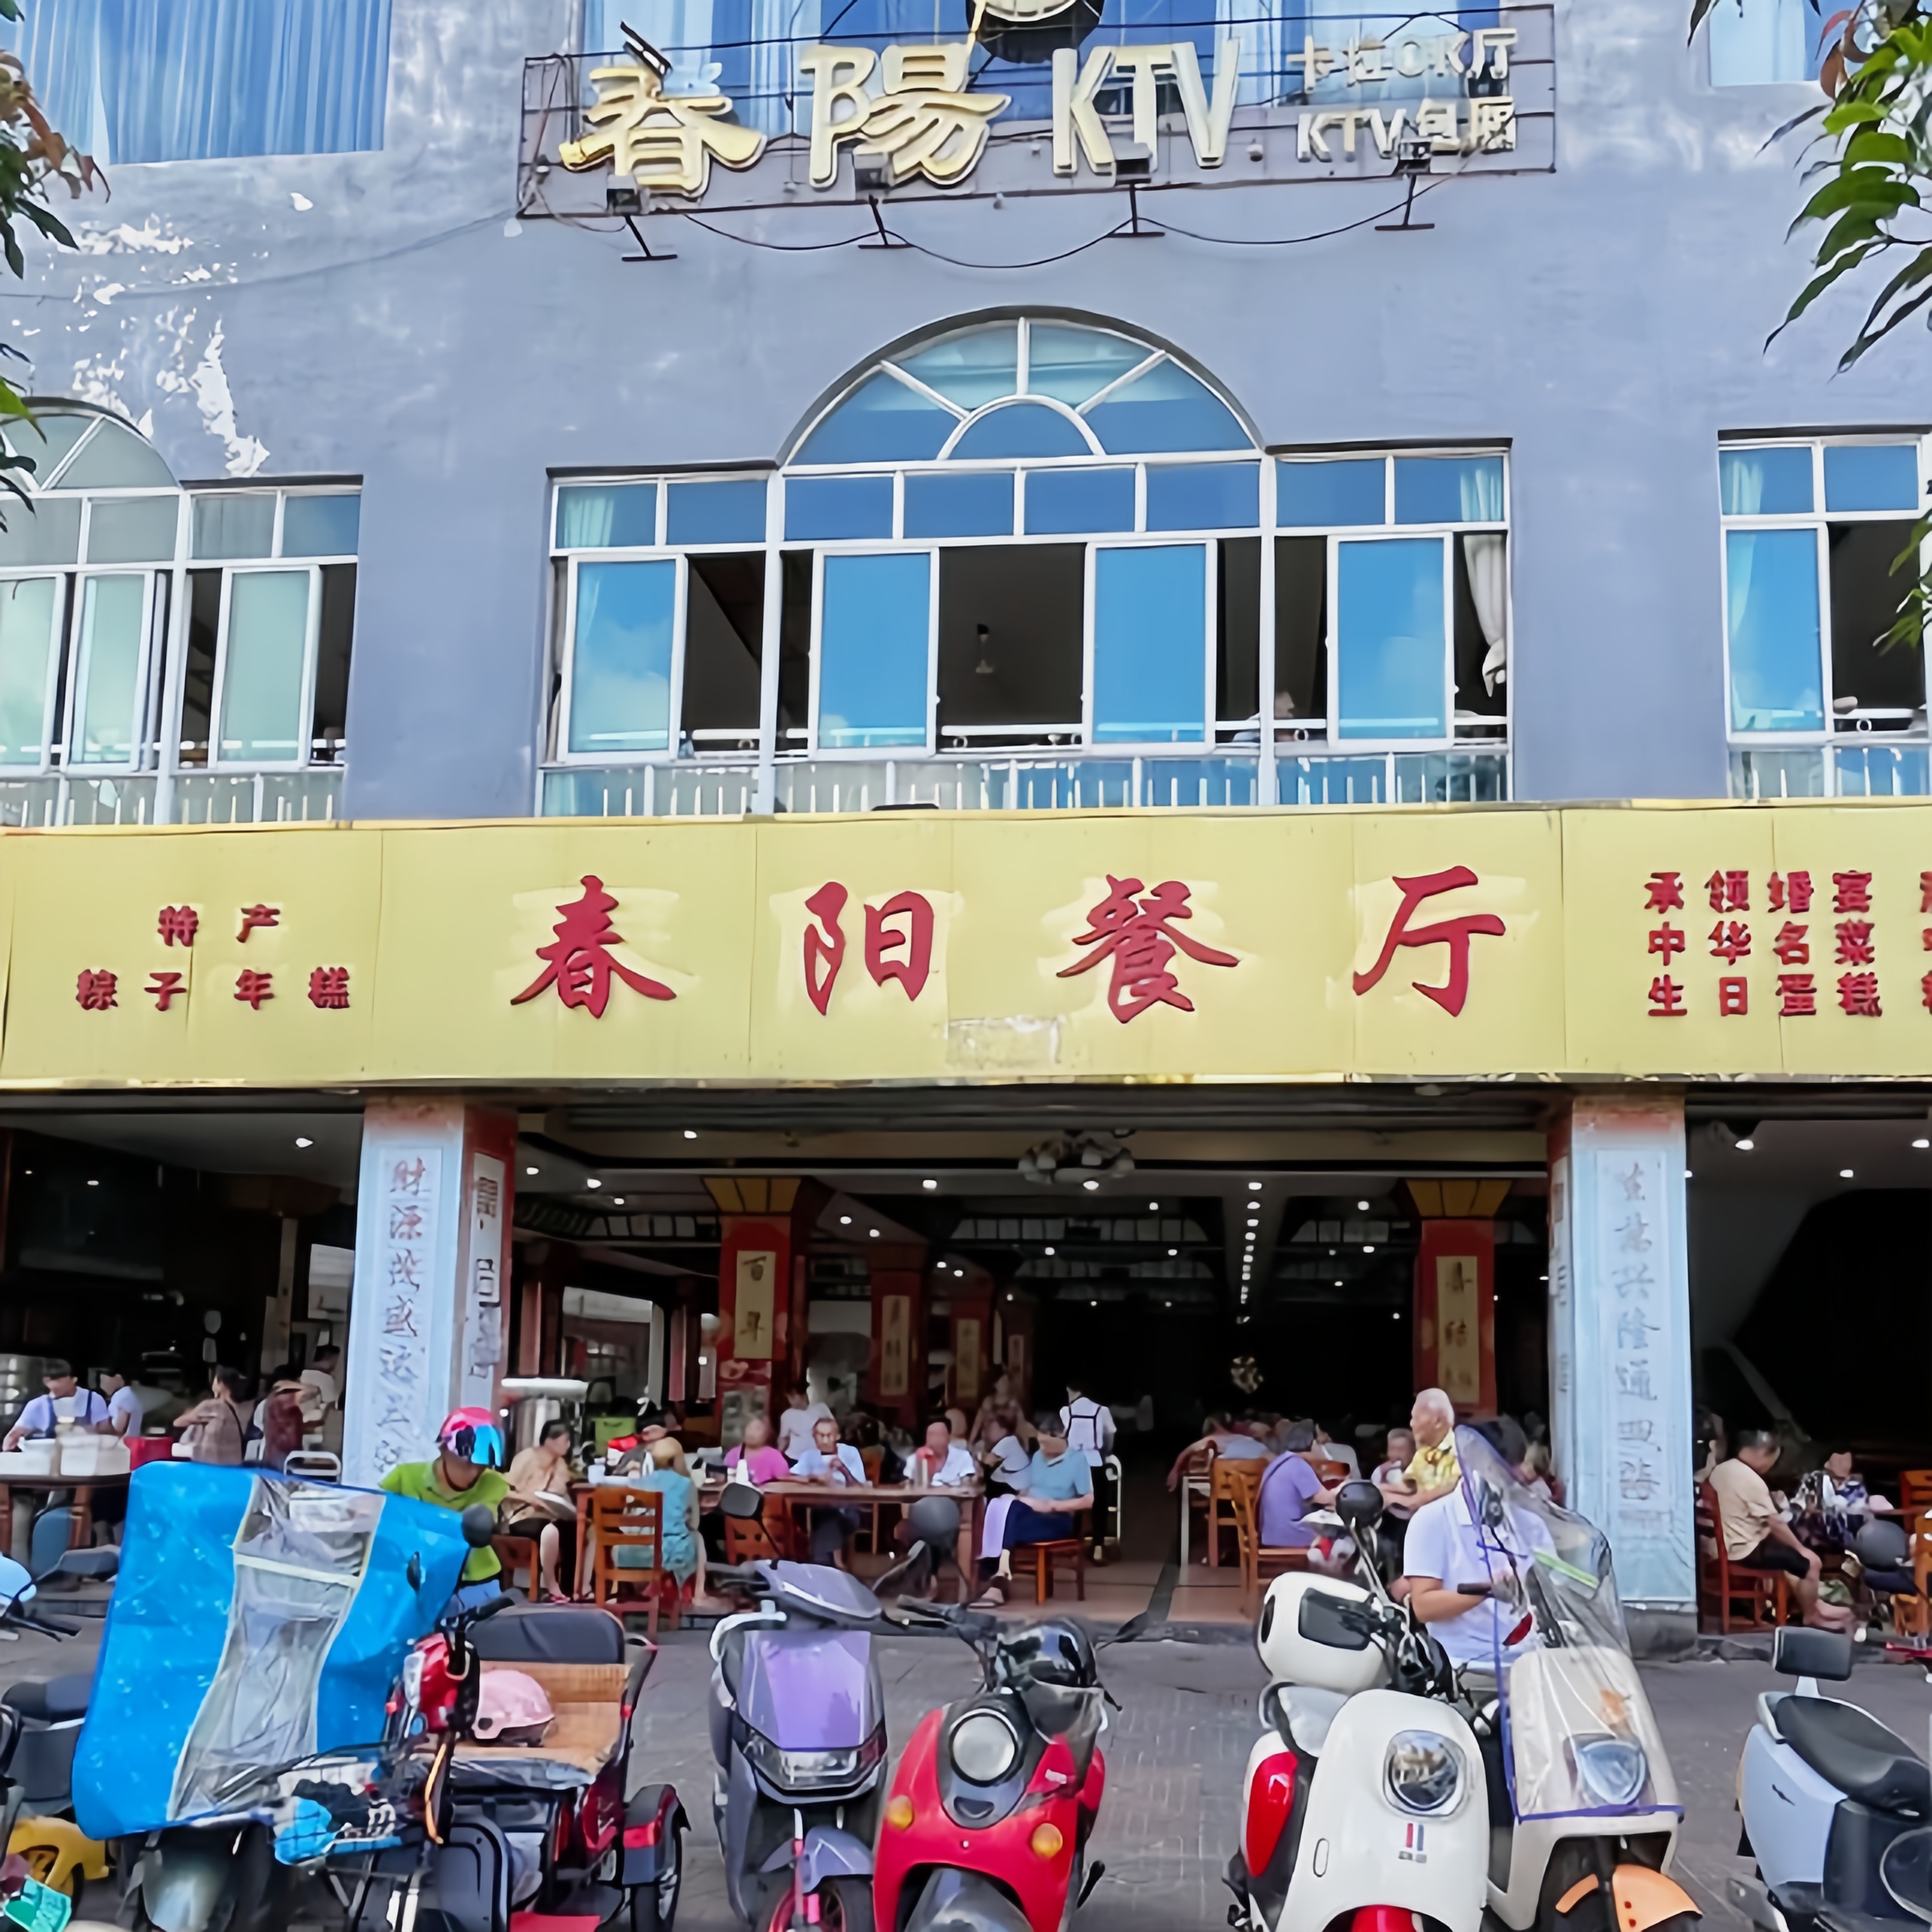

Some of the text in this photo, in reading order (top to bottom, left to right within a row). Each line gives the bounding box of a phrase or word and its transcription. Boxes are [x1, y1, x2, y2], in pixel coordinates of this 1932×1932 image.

[157, 903, 281, 947] 特产
[510, 865, 1507, 1024] 春阳餐厅
[1647, 918, 1875, 967] 中华名菜
[1647, 972, 1882, 1017] 生日蛋糕
